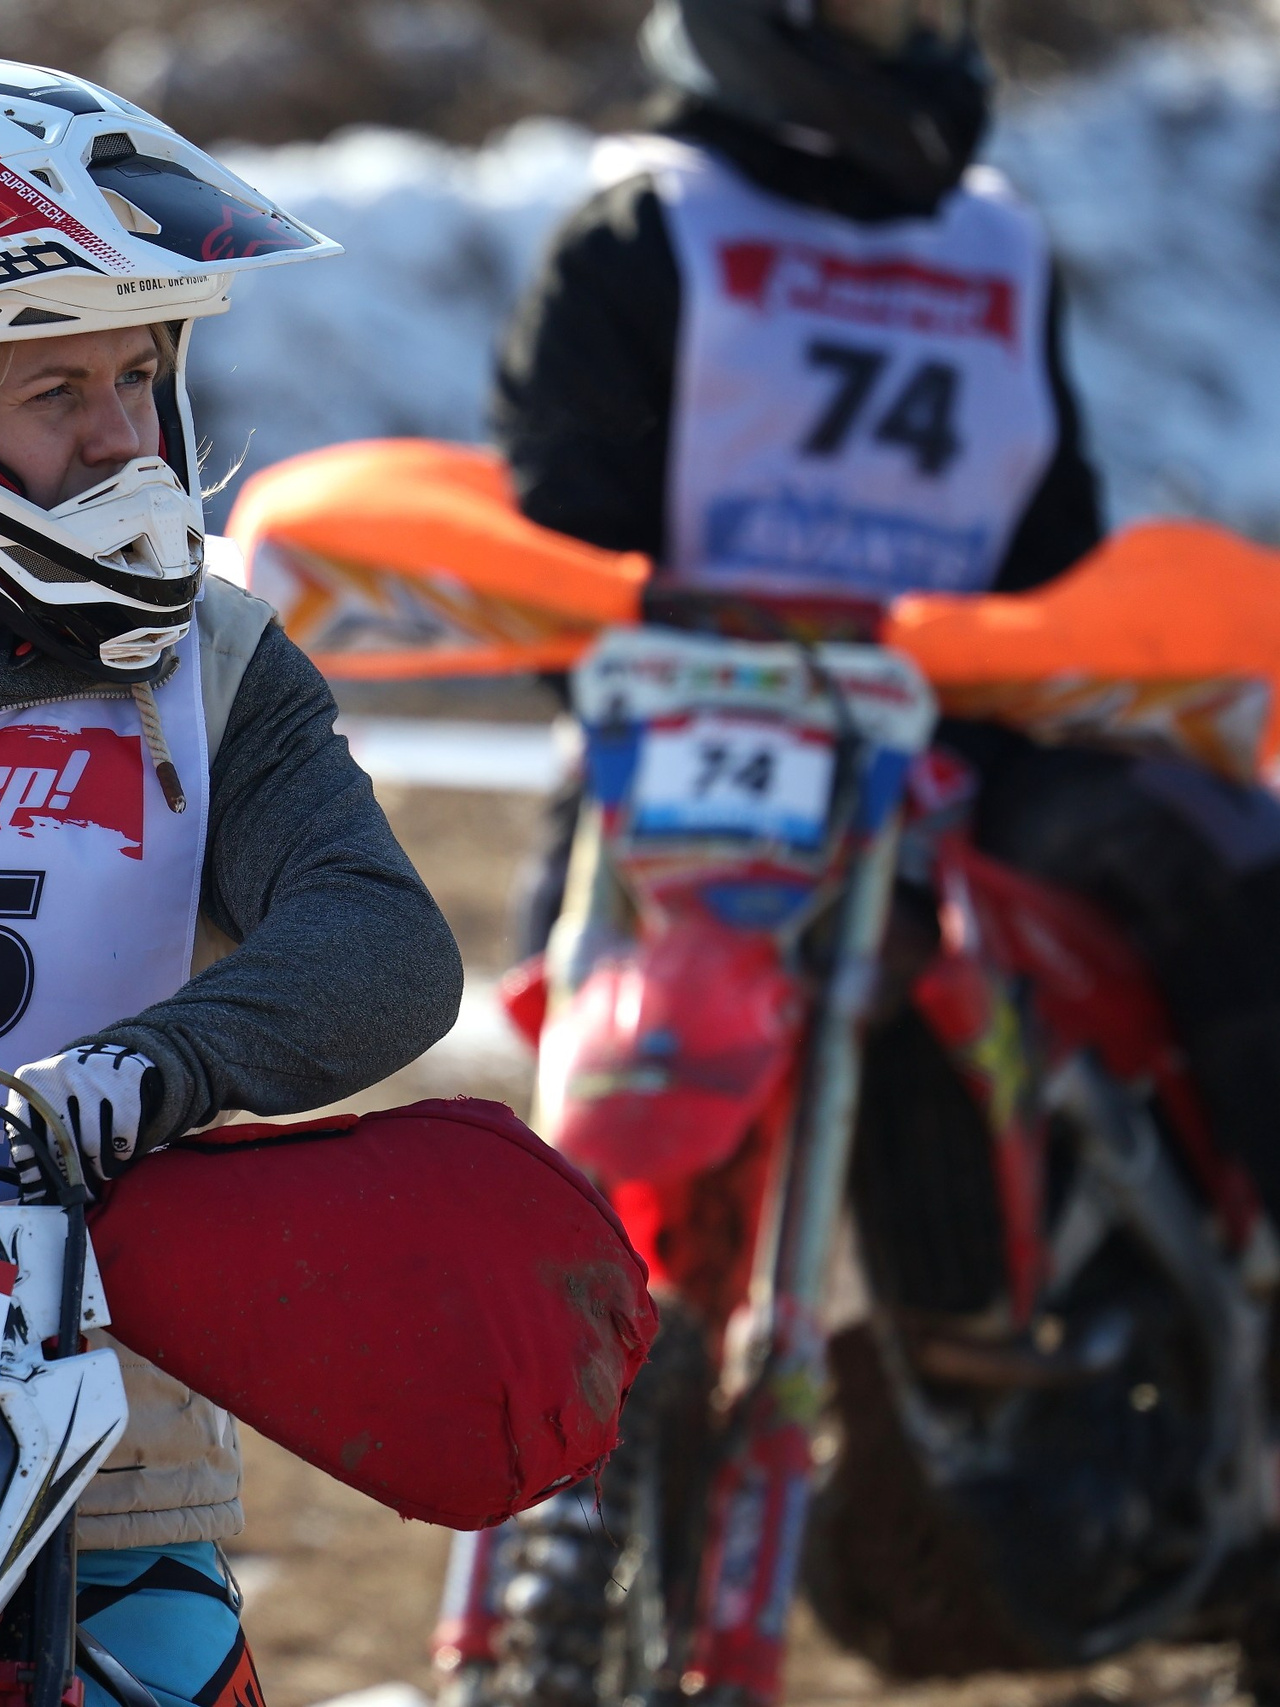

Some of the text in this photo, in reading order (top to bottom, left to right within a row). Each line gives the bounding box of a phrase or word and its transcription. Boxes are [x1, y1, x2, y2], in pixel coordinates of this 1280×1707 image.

[116, 281, 137, 296] ONE
[139, 278, 166, 292] GOAL.
[800, 340, 963, 479] 74
[695, 744, 777, 799] 74
